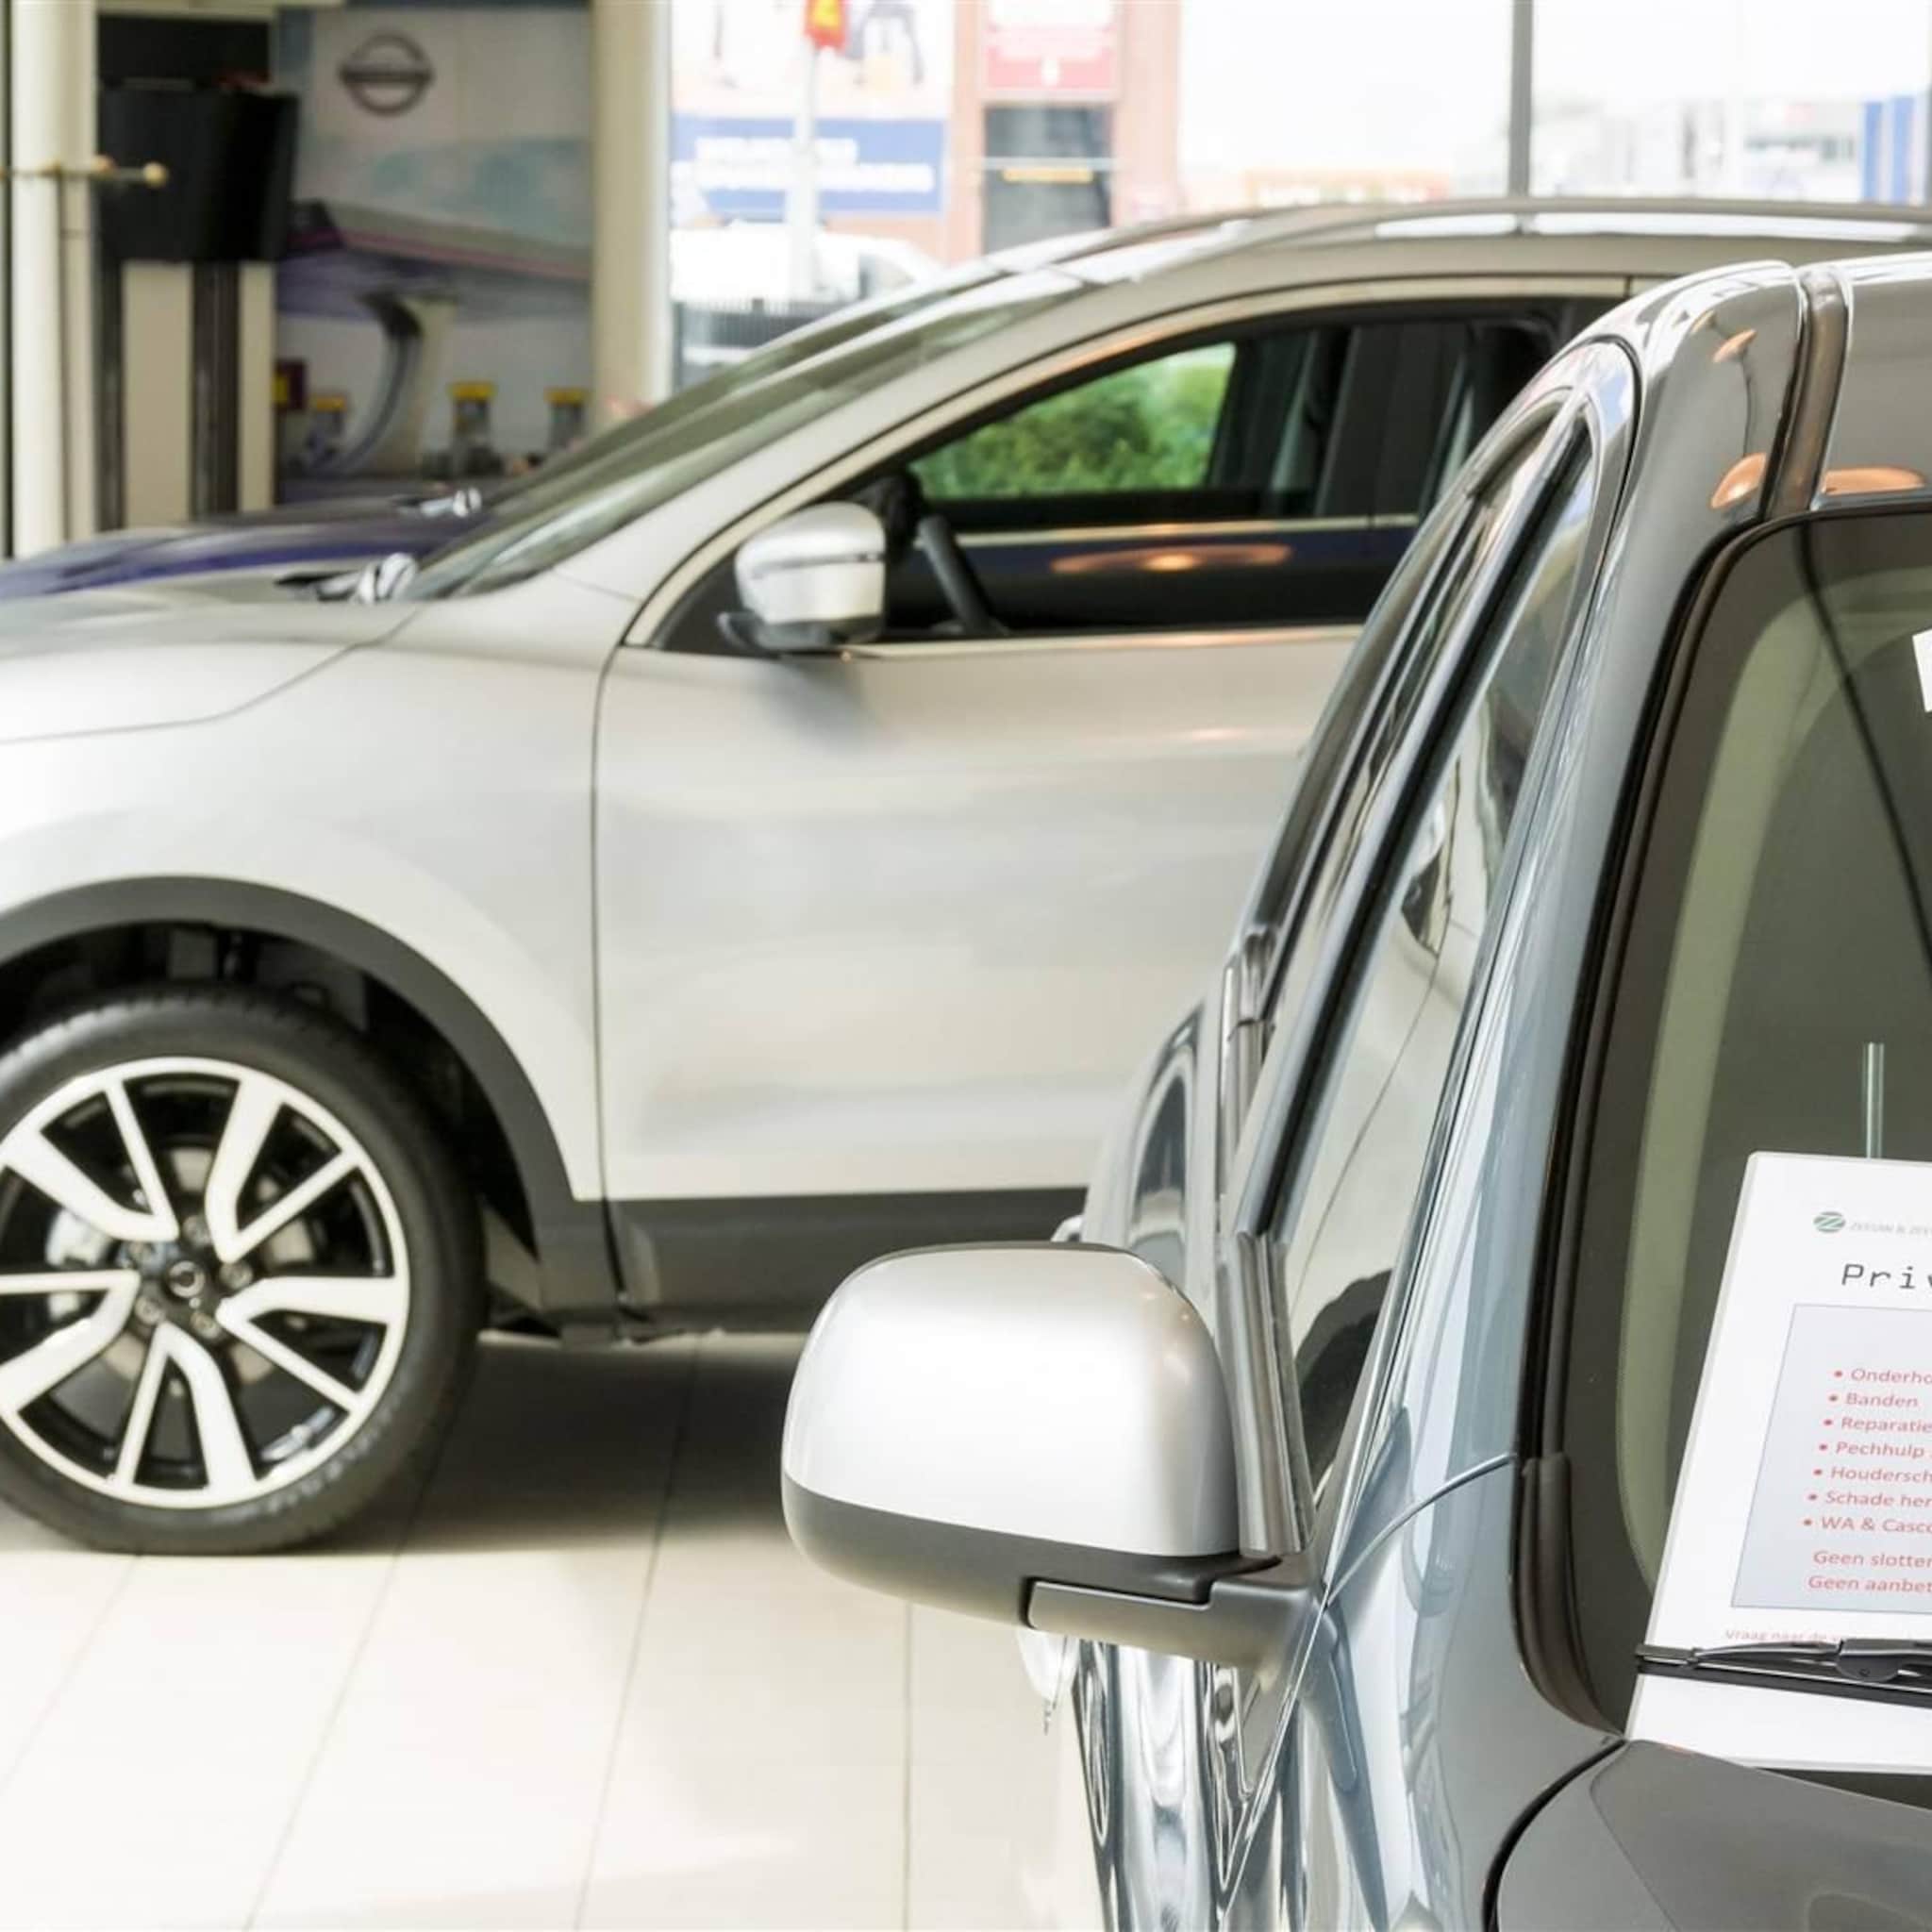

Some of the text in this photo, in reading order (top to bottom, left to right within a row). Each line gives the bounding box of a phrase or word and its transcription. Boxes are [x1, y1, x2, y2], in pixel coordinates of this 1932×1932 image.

[1840, 1262, 1932, 1290] Pri
[1851, 1367, 1932, 1385] Onderho
[1845, 1391, 1919, 1408] Banden
[1841, 1416, 1932, 1434] Reparatie
[1836, 1441, 1925, 1459] Pechhulp
[1830, 1465, 1932, 1483] Houdersch
[1824, 1490, 1895, 1507] Schade
[1821, 1516, 1855, 1530] WA
[1860, 1517, 1875, 1531] &
[1813, 1550, 1865, 1566] Geen
[1807, 1574, 1932, 1593] Geen aanbet
